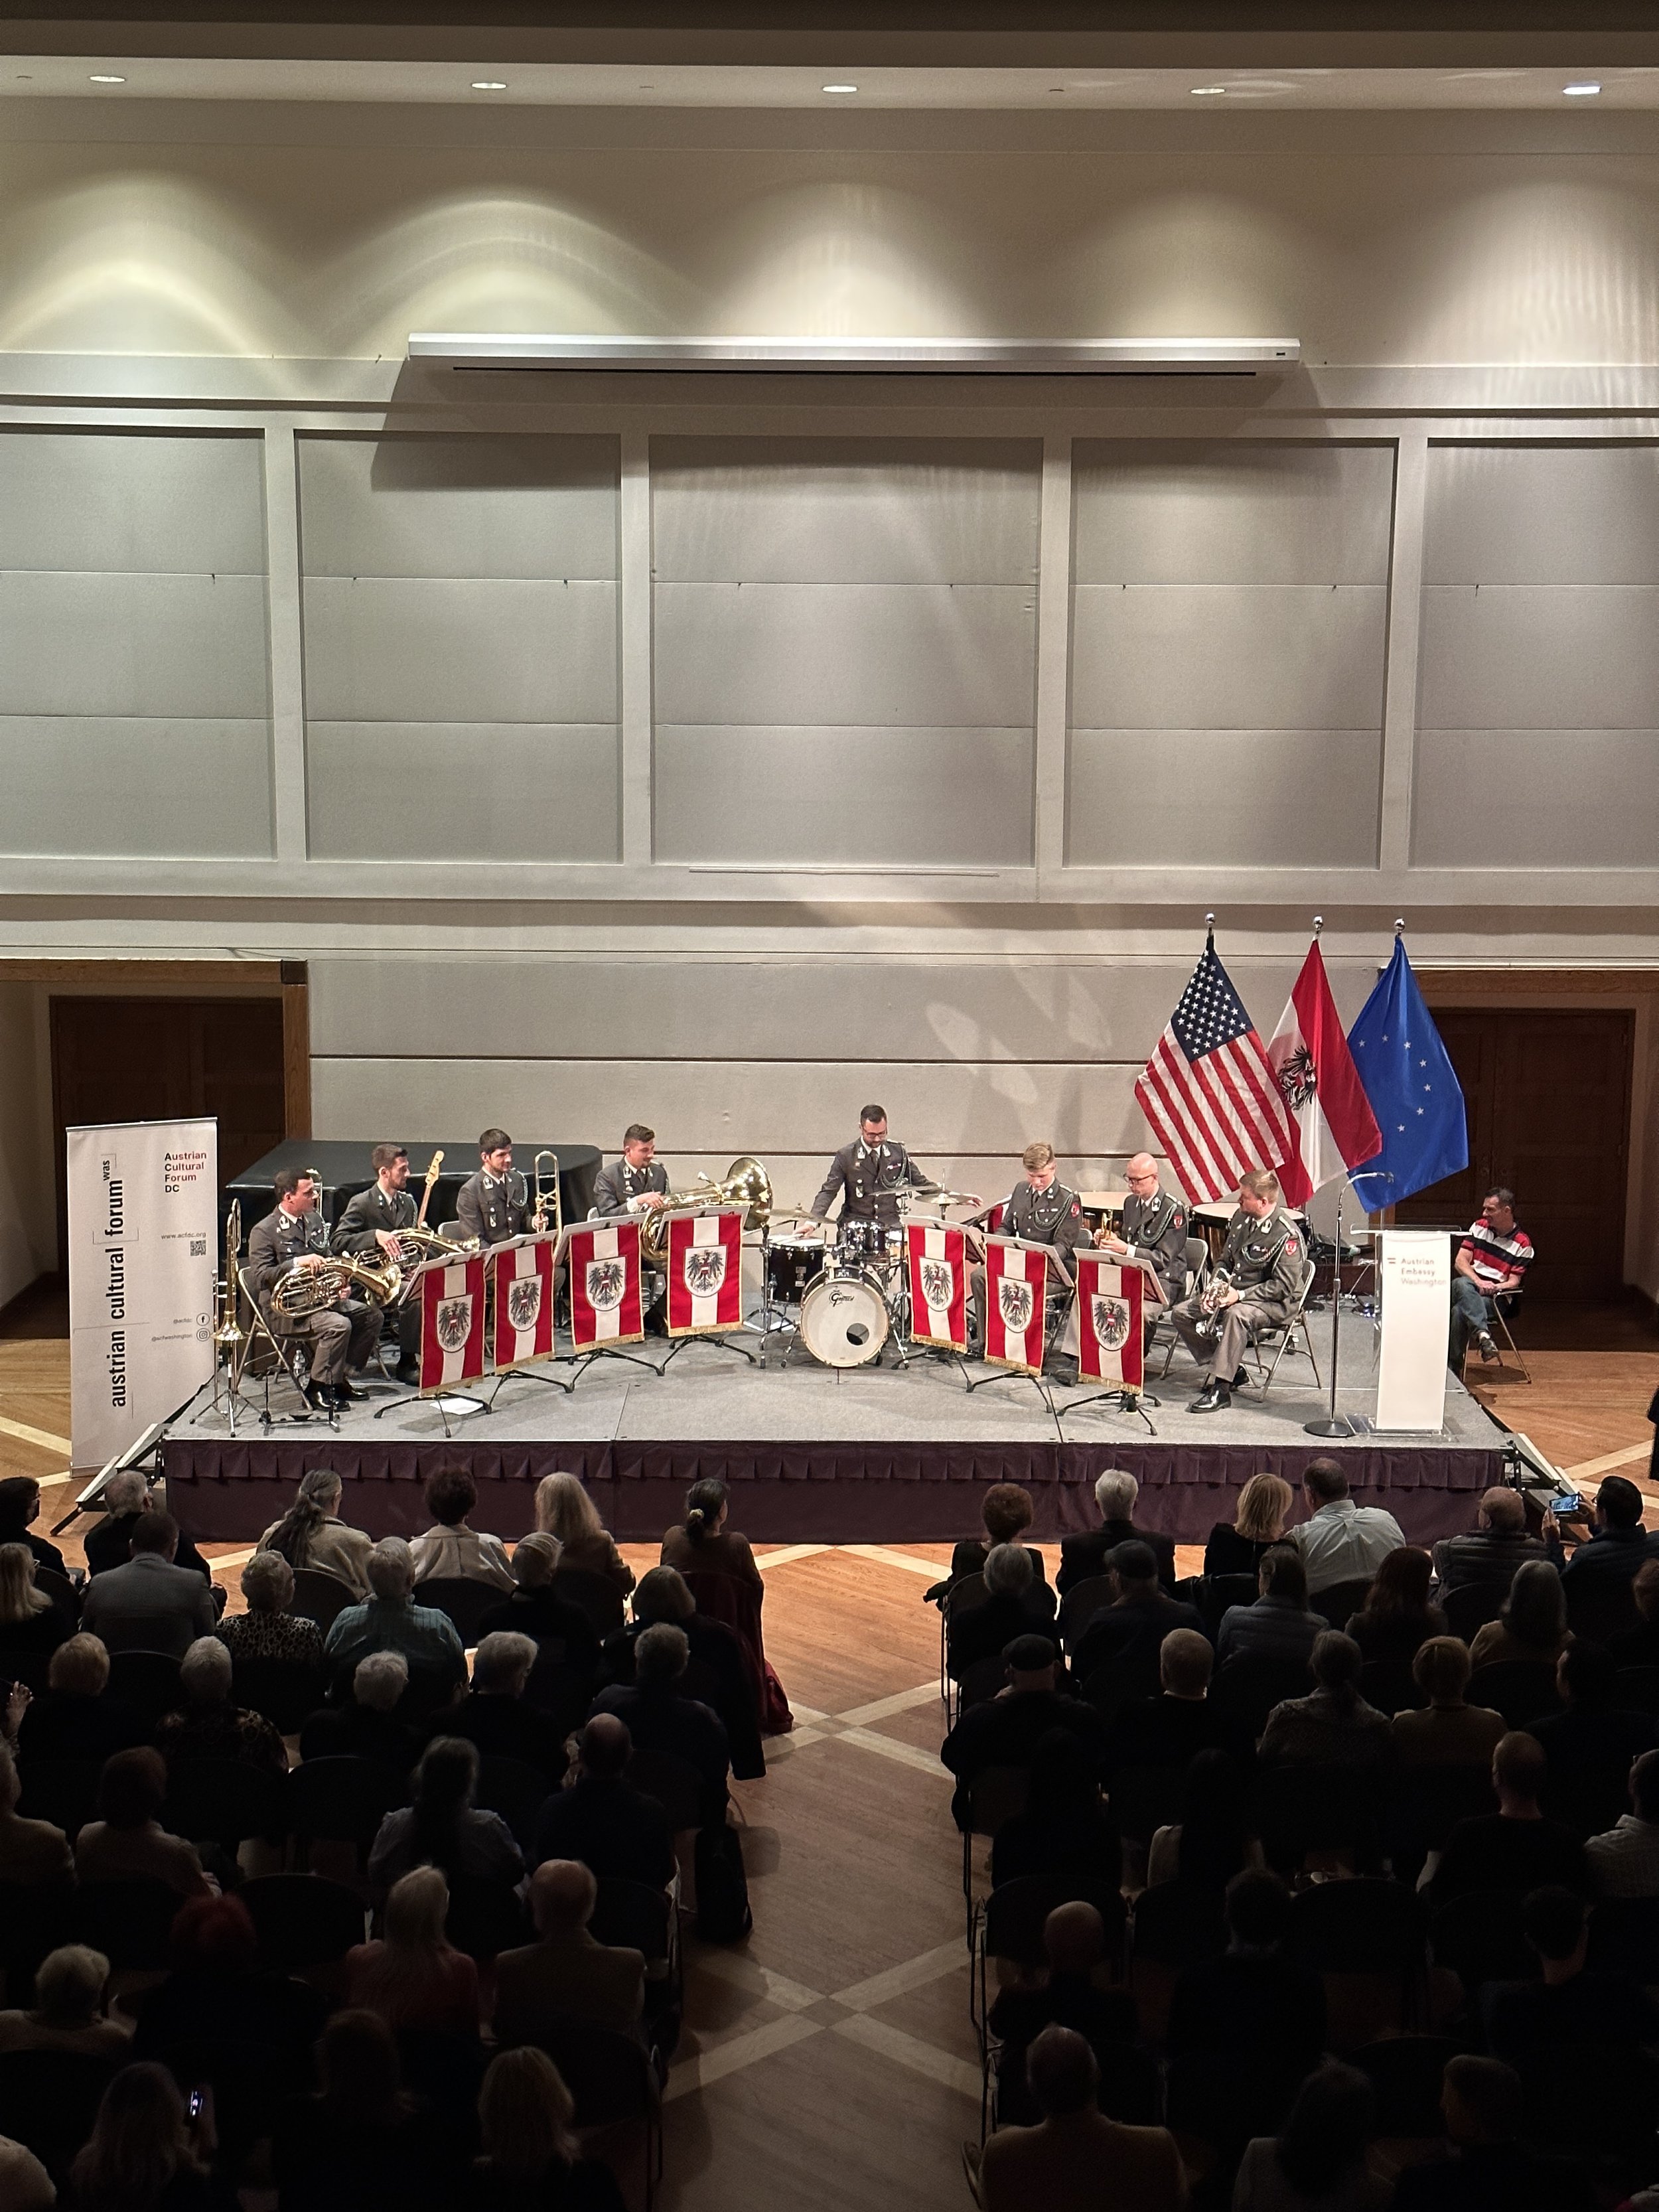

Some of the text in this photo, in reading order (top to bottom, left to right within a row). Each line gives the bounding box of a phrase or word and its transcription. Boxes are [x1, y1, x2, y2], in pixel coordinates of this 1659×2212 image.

[165, 1151, 207, 1161] Austrian
[165, 1161, 204, 1172] Cultural
[165, 1173, 197, 1183] Forum
[165, 1184, 180, 1193] DC
[1401, 1268, 1435, 1277] Embassy
[1401, 1278, 1447, 1288] Washington
[104, 1179, 126, 1408] austrian cultural forum
